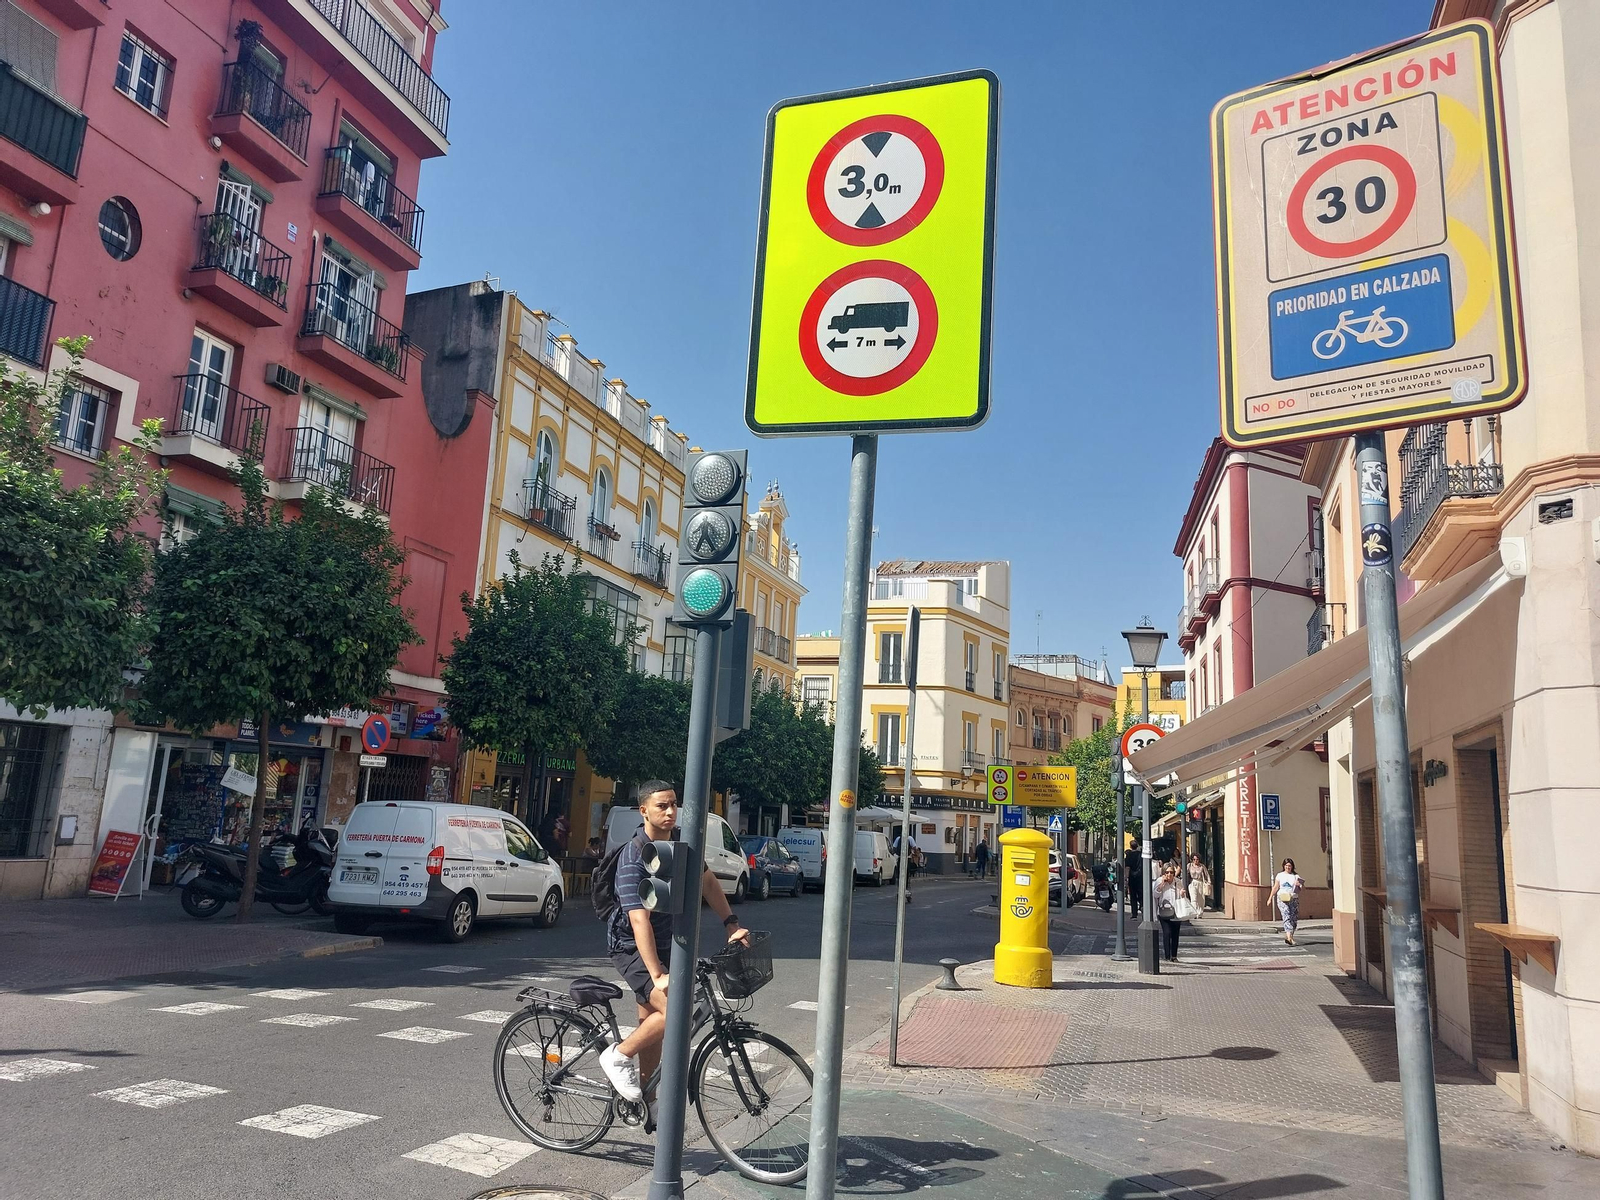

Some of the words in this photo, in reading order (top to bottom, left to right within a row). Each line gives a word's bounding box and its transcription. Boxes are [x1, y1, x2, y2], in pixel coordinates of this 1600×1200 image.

[1250, 52, 1457, 135] ATENCIÓN
[1297, 111, 1398, 156] ZONA
[1315, 176, 1387, 224] 30
[1276, 287, 1347, 317] PRIORIDAD
[1351, 282, 1369, 301] EN
[1373, 267, 1441, 296] CALZADA
[1309, 382, 1364, 398] DELEGACIÓN
[1365, 380, 1377, 388] DE
[1380, 372, 1431, 385] SEGURIDAD
[1434, 362, 1486, 377] MOVILIDAD
[1360, 387, 1396, 398] FIESTAS
[1398, 379, 1443, 392] MAYORES
[1252, 403, 1270, 414] NO
[1277, 398, 1296, 410] DO
[418, 712, 437, 720] Tickets
[546, 758, 576, 771] URBANA
[1031, 772, 1070, 781] ATENCIÓN
[1267, 800, 1276, 814] P
[372, 834, 391, 843] PUERTA
[391, 835, 398, 843] DE
[399, 835, 425, 844] CARMONA
[345, 873, 361, 881] 7231
